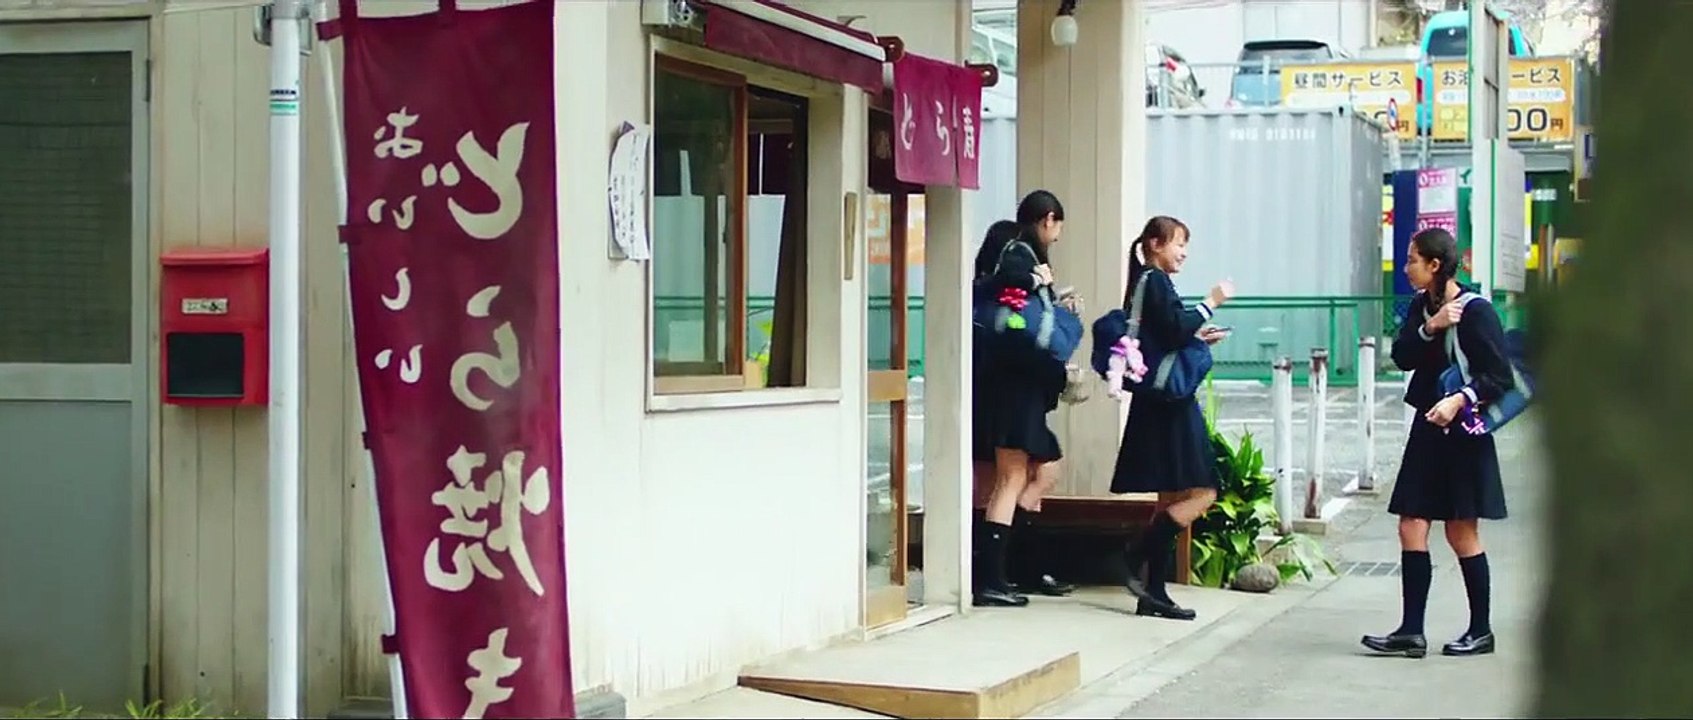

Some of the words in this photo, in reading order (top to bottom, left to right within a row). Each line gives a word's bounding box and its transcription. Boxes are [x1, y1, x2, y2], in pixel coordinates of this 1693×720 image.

[1294, 71, 1401, 88] 昼間サービス
